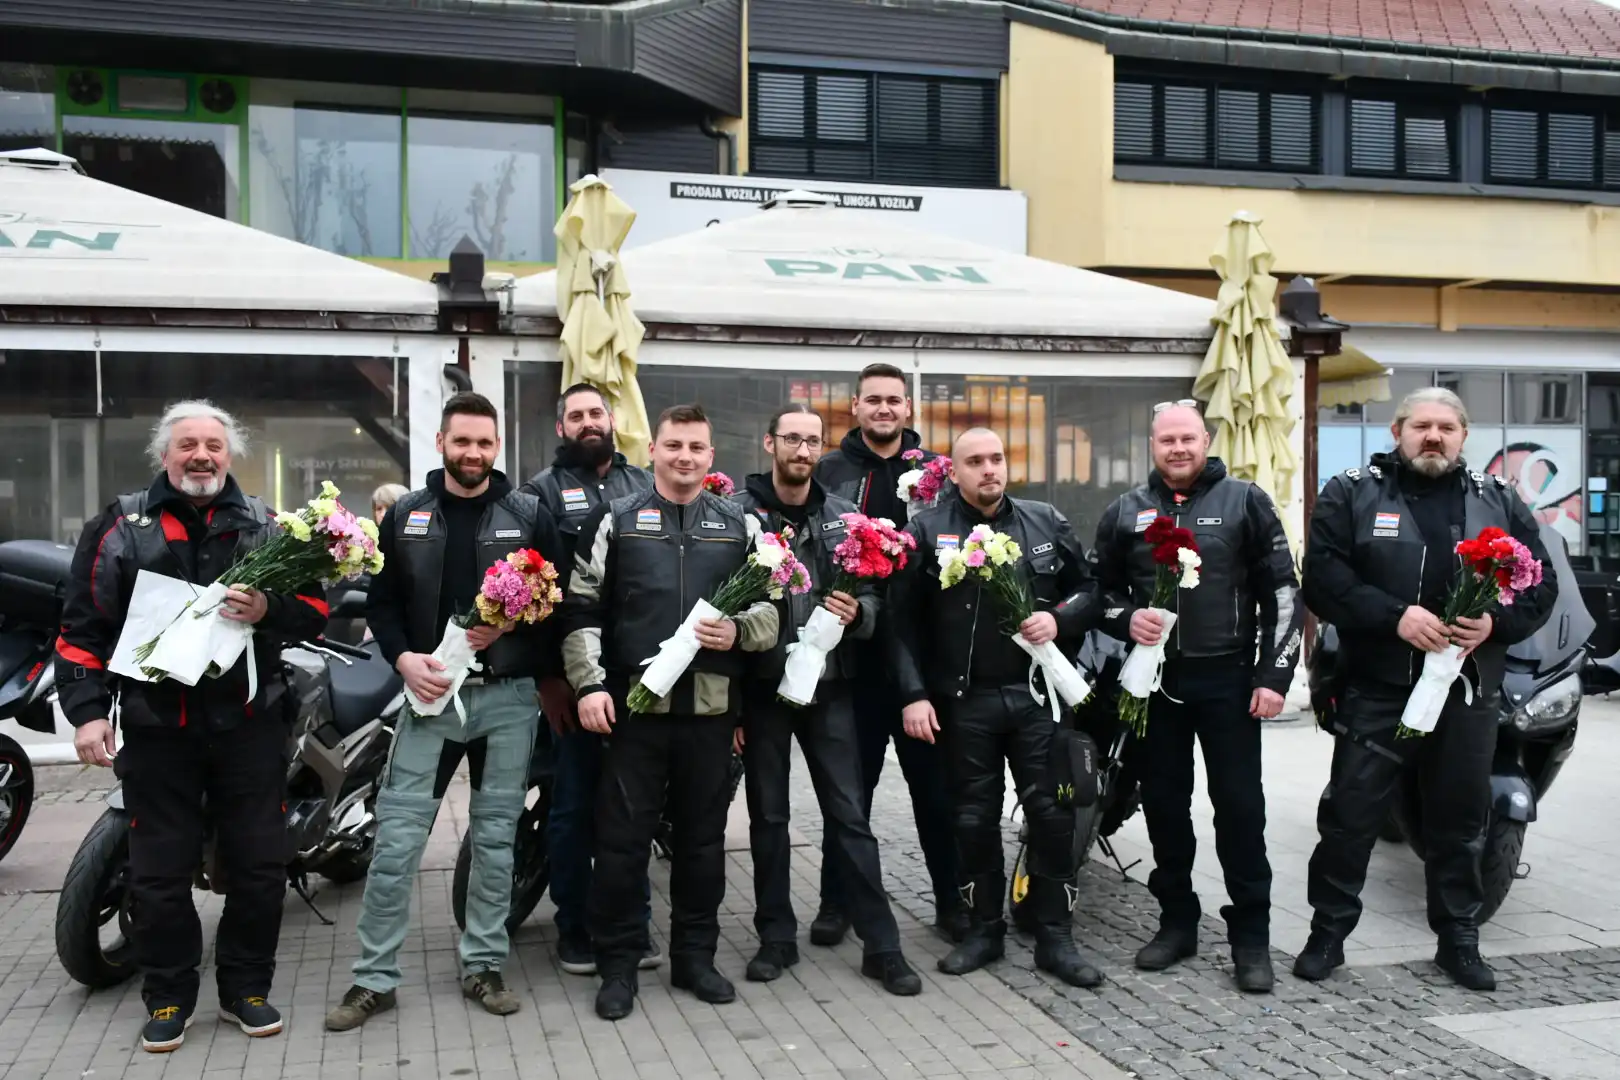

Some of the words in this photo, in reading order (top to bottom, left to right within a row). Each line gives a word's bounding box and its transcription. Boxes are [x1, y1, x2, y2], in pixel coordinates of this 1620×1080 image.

[676, 184, 723, 199] PRODAJA
[724, 187, 762, 201] VOZILA
[842, 194, 878, 208] UNOSA
[878, 196, 915, 210] VOZILA
[764, 258, 991, 284] PAN
